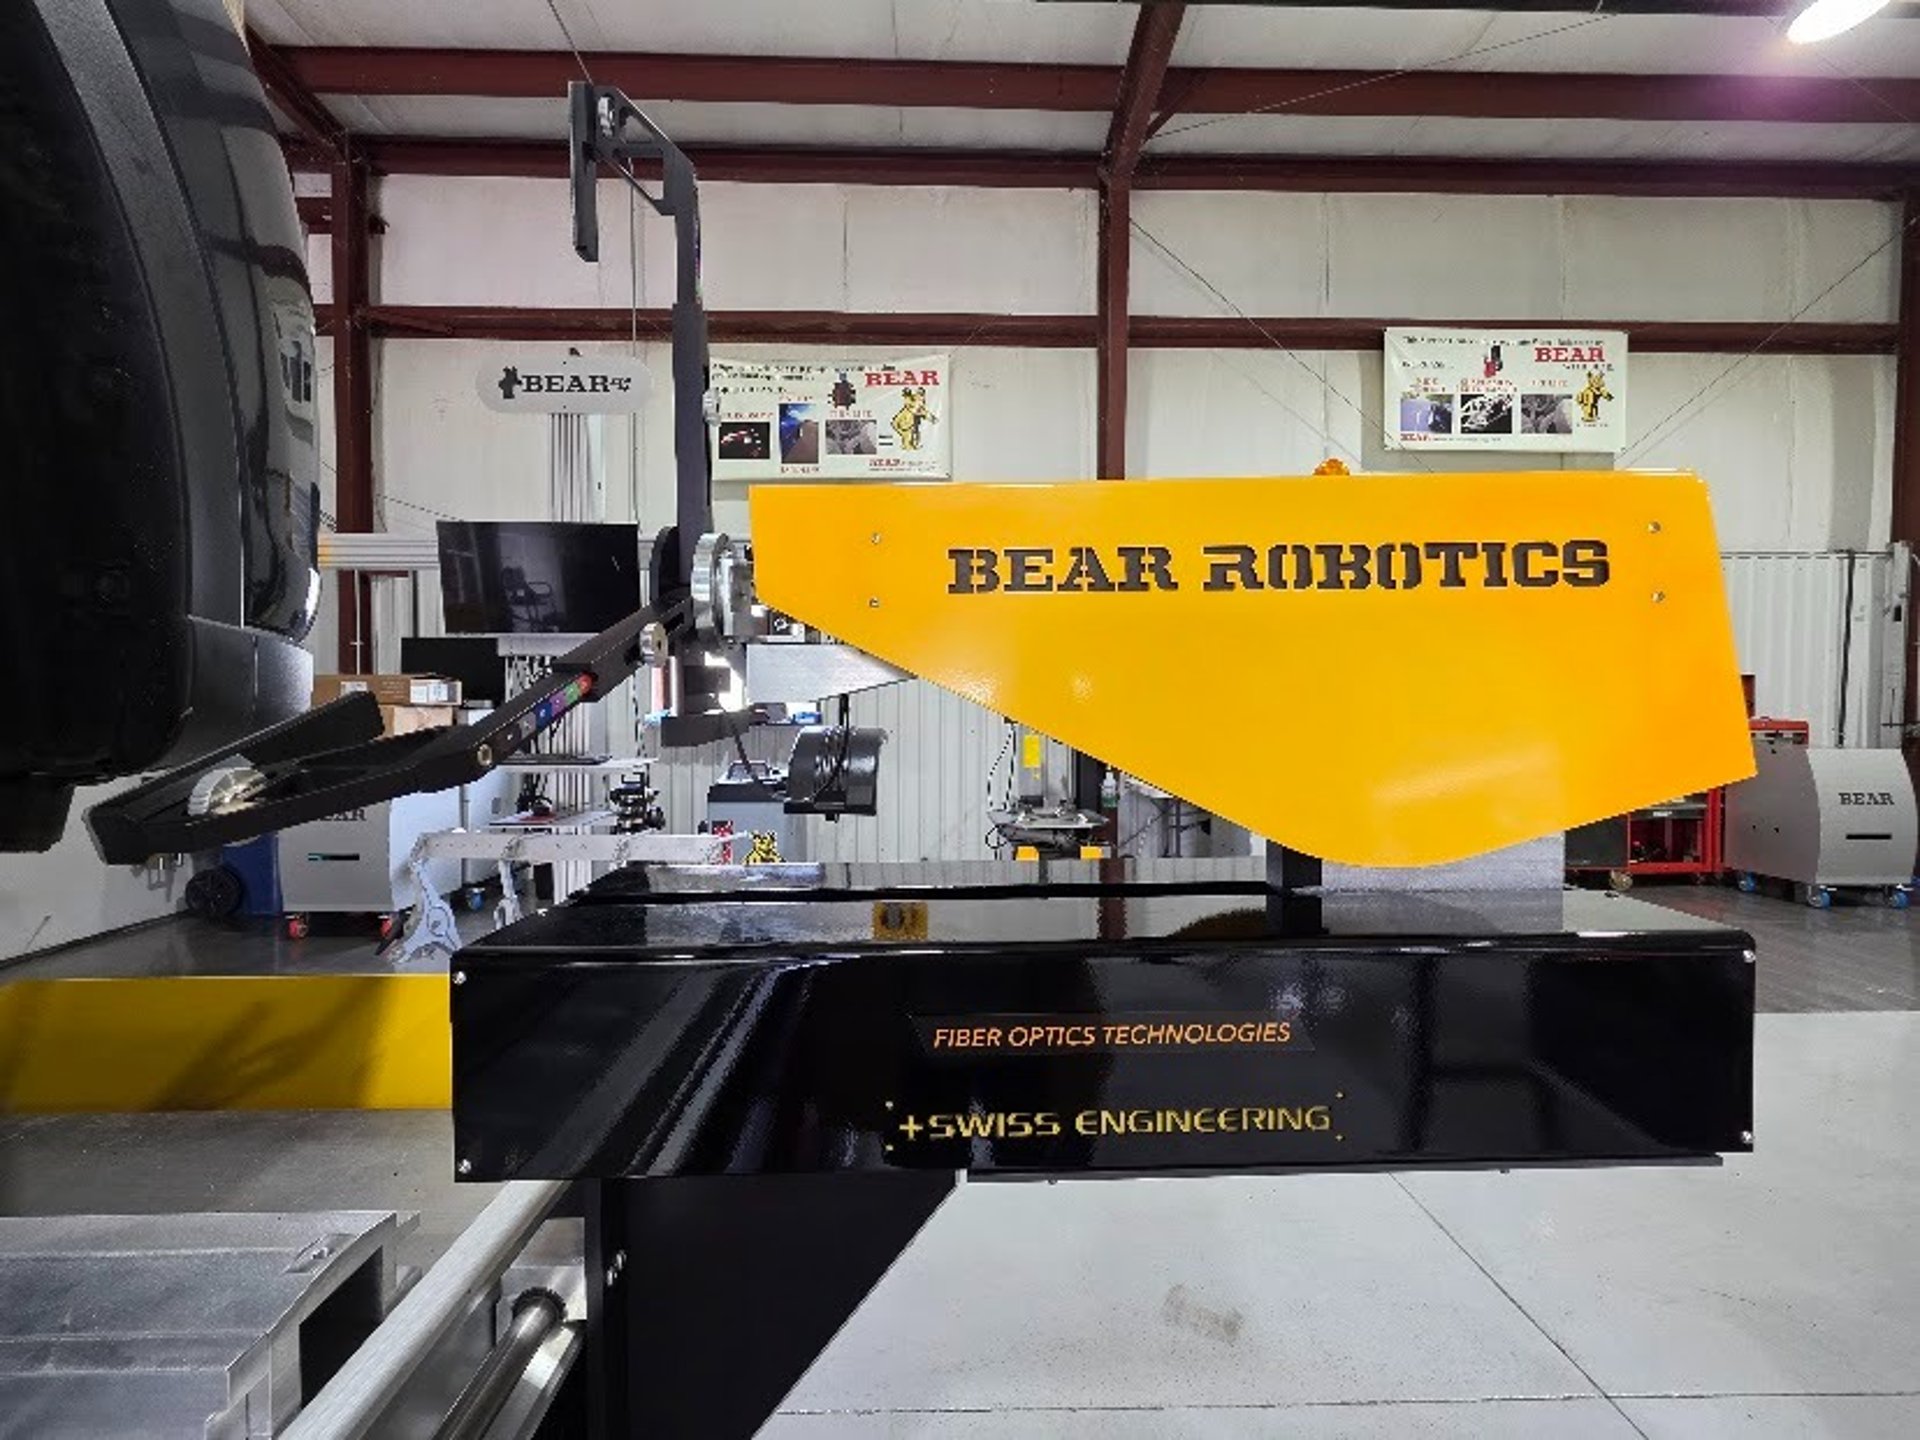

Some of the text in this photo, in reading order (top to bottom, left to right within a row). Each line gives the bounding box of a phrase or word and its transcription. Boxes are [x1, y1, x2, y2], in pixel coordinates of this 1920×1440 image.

[1534, 347, 1606, 363] BEAR
[521, 375, 611, 393] BEAR
[864, 370, 940, 388] BEAR
[947, 539, 1611, 595] BEAR ROBOTICS
[1839, 793, 1895, 806] BEAR
[933, 1022, 1291, 1049] FIBER OPTICS TECHNOLOGIES
[1075, 1105, 1332, 1136] ENGINEERING
